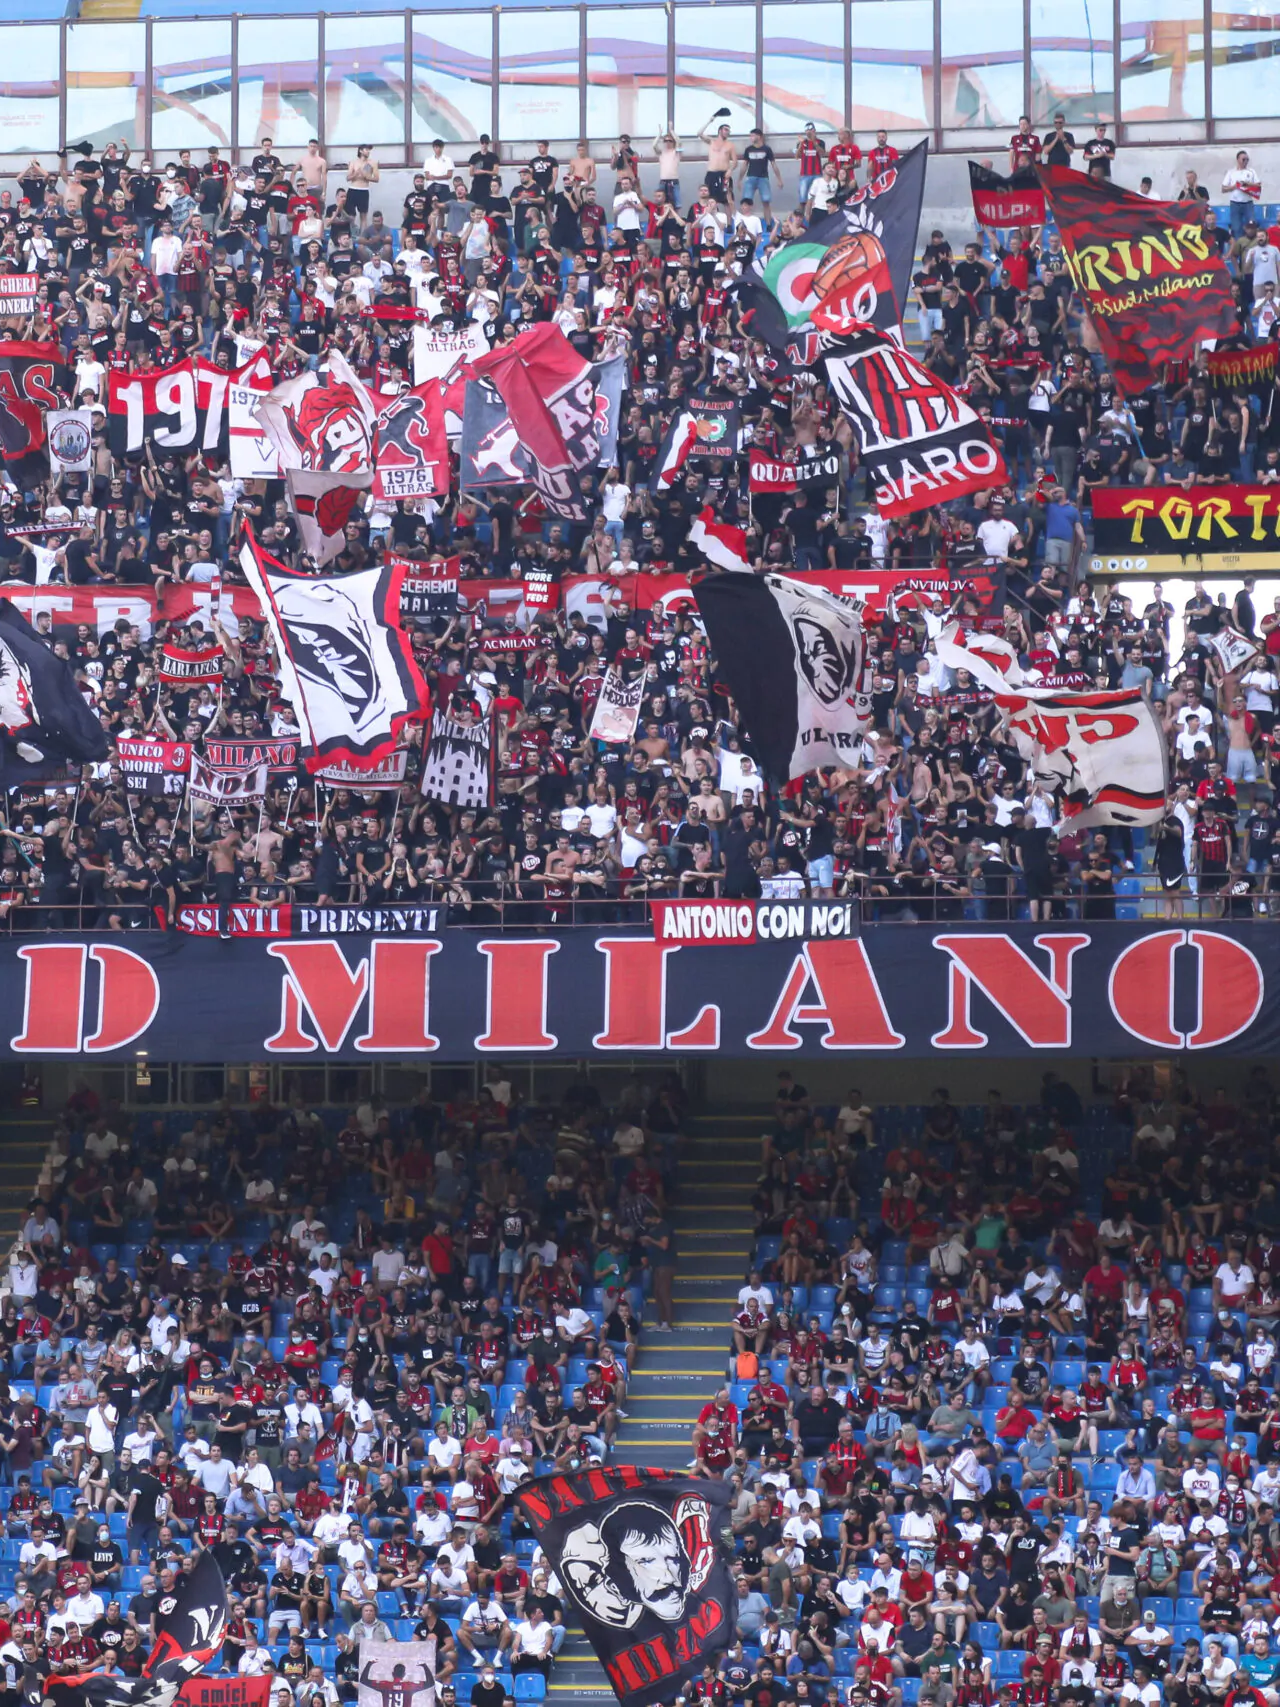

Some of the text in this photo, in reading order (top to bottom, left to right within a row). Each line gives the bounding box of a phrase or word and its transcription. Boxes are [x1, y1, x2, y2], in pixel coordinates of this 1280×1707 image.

[431, 330, 470, 343] 1976
[427, 341, 476, 353] ULTRAS
[1208, 352, 1273, 388] TORINO
[231, 389, 259, 404] 197
[116, 362, 228, 452] 197
[690, 400, 733, 410] QUARTO
[387, 469, 426, 484] 1976
[751, 457, 838, 483] QUARTO
[384, 482, 434, 497] ULTRAS
[1121, 494, 1280, 543] TORI
[430, 562, 447, 576] TI
[524, 572, 553, 582] CUORE
[400, 579, 457, 594] SCEREMO
[528, 583, 548, 592] UNA
[526, 593, 549, 603] FEDE
[801, 728, 864, 749] ULTRA
[119, 743, 164, 758] UNICO
[207, 745, 298, 767] MILANO
[120, 760, 164, 775] AMORE
[126, 776, 148, 790] SEI
[301, 909, 439, 932] PRESENTI
[663, 906, 753, 940] ANTONIO
[757, 905, 807, 939] CON
[264, 928, 1265, 1055] MILANO
[201, 1683, 247, 1702] amici
